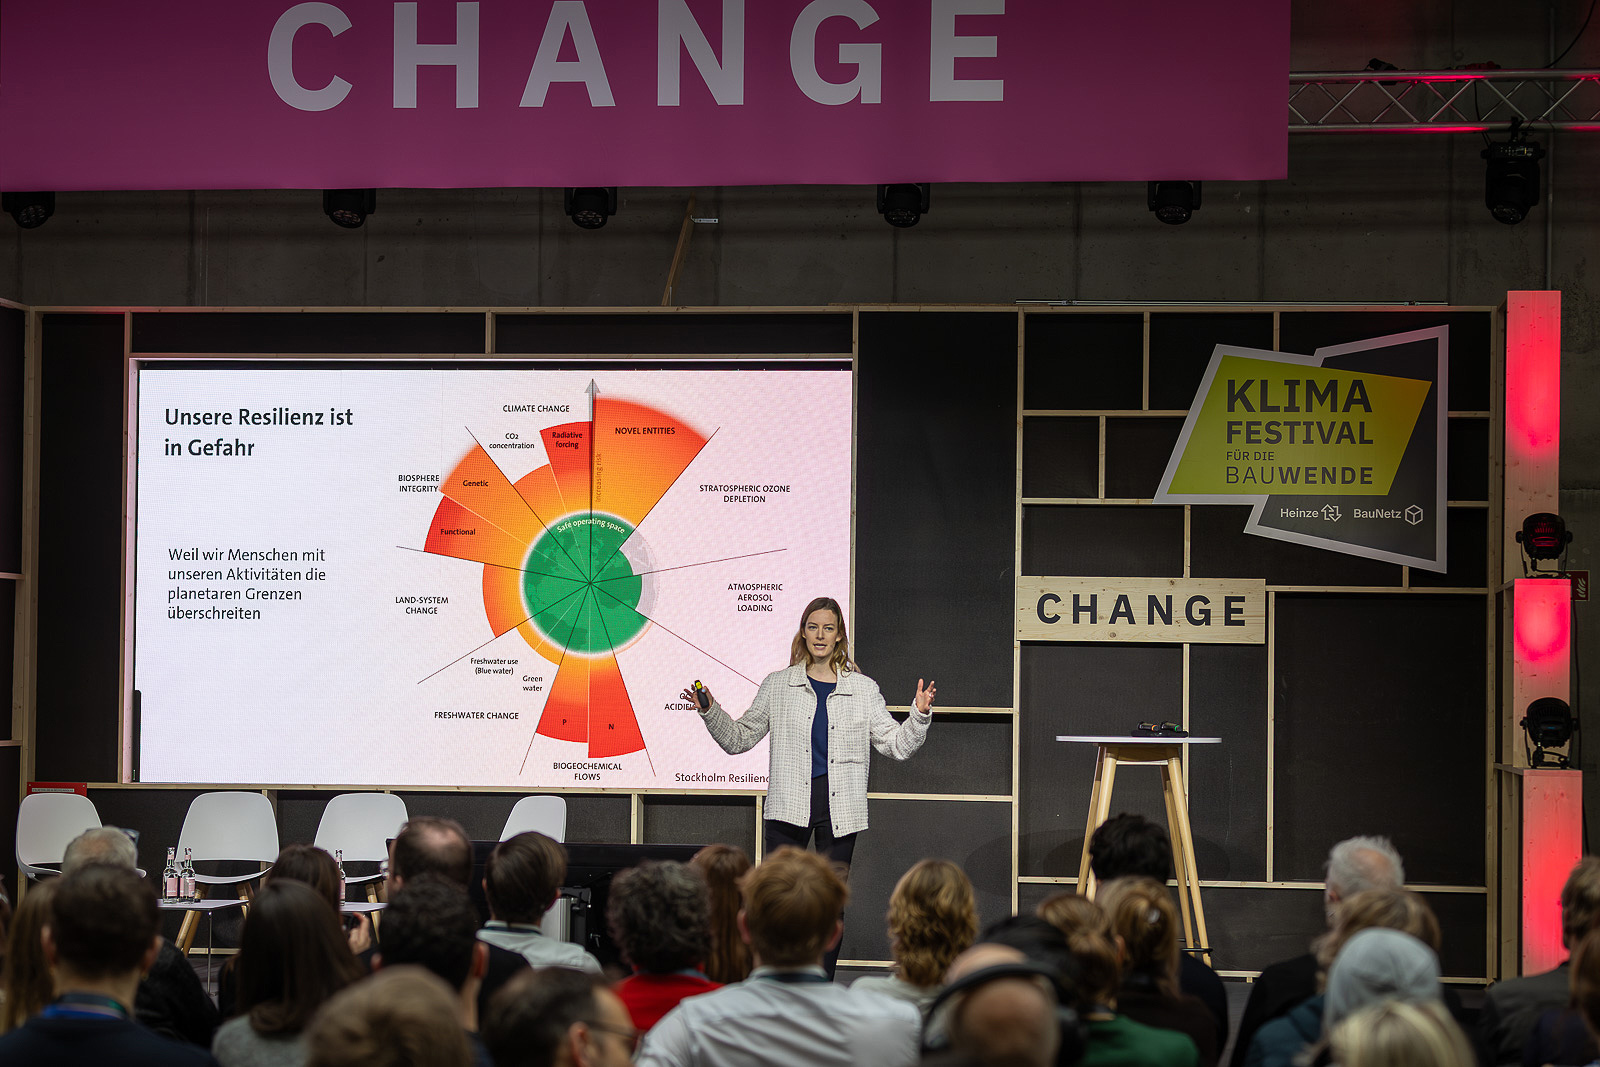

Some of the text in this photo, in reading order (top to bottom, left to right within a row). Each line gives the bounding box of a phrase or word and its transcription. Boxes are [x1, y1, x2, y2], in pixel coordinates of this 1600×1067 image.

[267, 0, 1005, 111] CHANGE
[1227, 380, 1372, 412] KLIMA
[165, 408, 353, 425] Unsere Resilienz ist
[1226, 421, 1374, 444] FESTIVAL
[164, 439, 254, 456] in Gefahr
[1226, 450, 1274, 460] FÜR DIE
[1226, 466, 1373, 484] BAUWENDE
[700, 485, 790, 493] STRATOSPHERIC OZONE
[1280, 508, 1319, 518] Heinze
[1354, 509, 1401, 519] BauNetz
[557, 518, 625, 534] Safe operating space
[168, 548, 325, 562] Weil wir Menschen mit
[168, 568, 326, 581] unseren Aktivitäten die
[168, 588, 302, 603] planetaren Grenzen
[167, 607, 261, 620] überschreiten
[1037, 593, 1246, 626] CHANGE
[475, 667, 514, 675] (Blue water)
[553, 762, 622, 770] BIOGEOCHEMICAL
[676, 773, 725, 782] Stockholm
